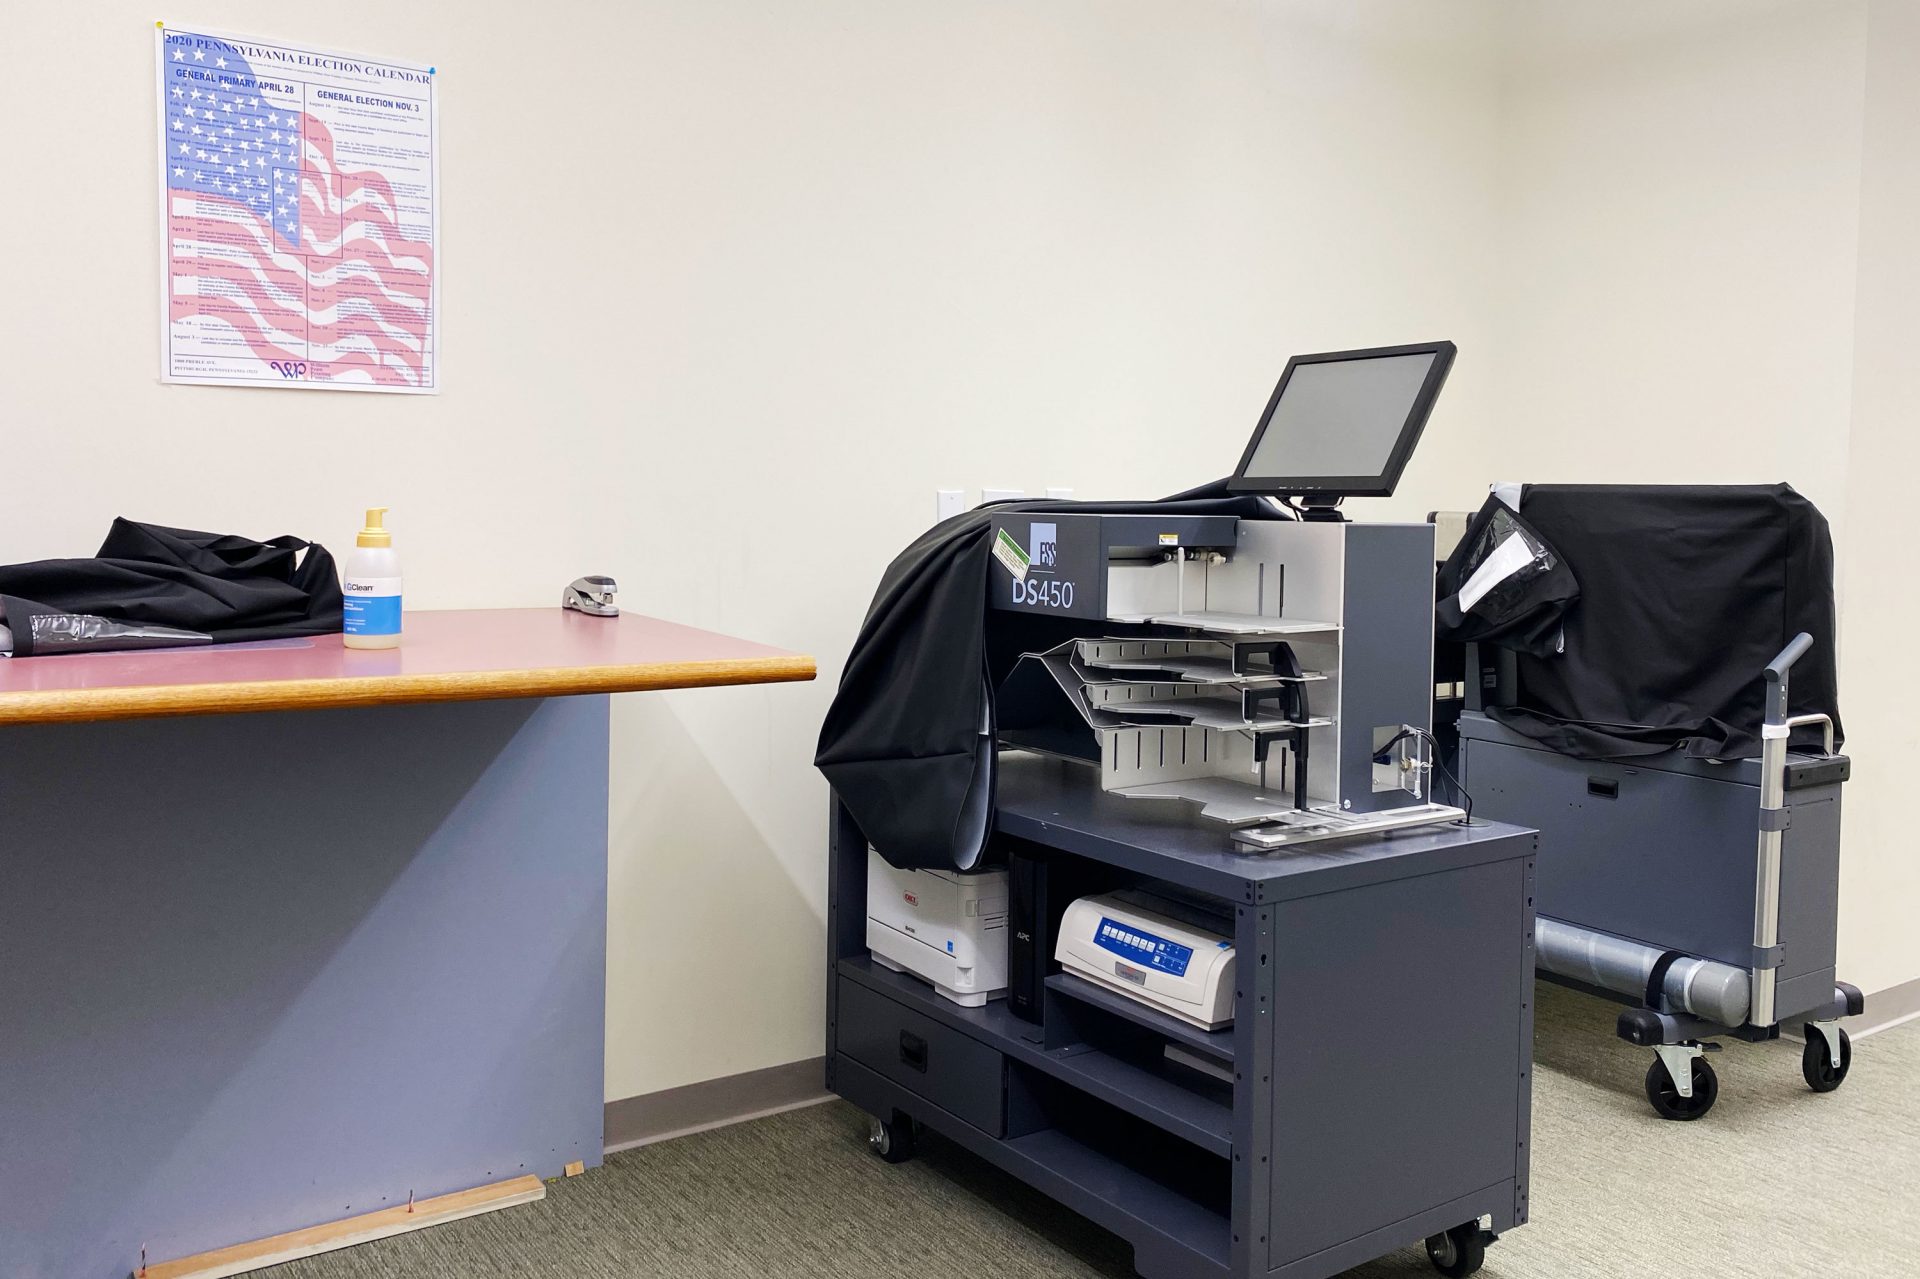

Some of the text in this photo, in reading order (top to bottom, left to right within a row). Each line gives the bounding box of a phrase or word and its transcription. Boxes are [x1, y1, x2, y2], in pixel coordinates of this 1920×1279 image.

[165, 34, 192, 47] 2020
[196, 39, 294, 63] PENNSYLVANIA
[298, 55, 362, 73] ELECTION
[365, 66, 430, 84] CALENDAR
[176, 69, 294, 94] GENERAL PRIMARY APRIL 28
[317, 90, 354, 103] GENERAL
[355, 95, 394, 109] ELECTION
[395, 102, 413, 112] NOV.
[414, 104, 420, 112] 3
[1012, 577, 1074, 609] DS450
[1016, 931, 1030, 942] APC
